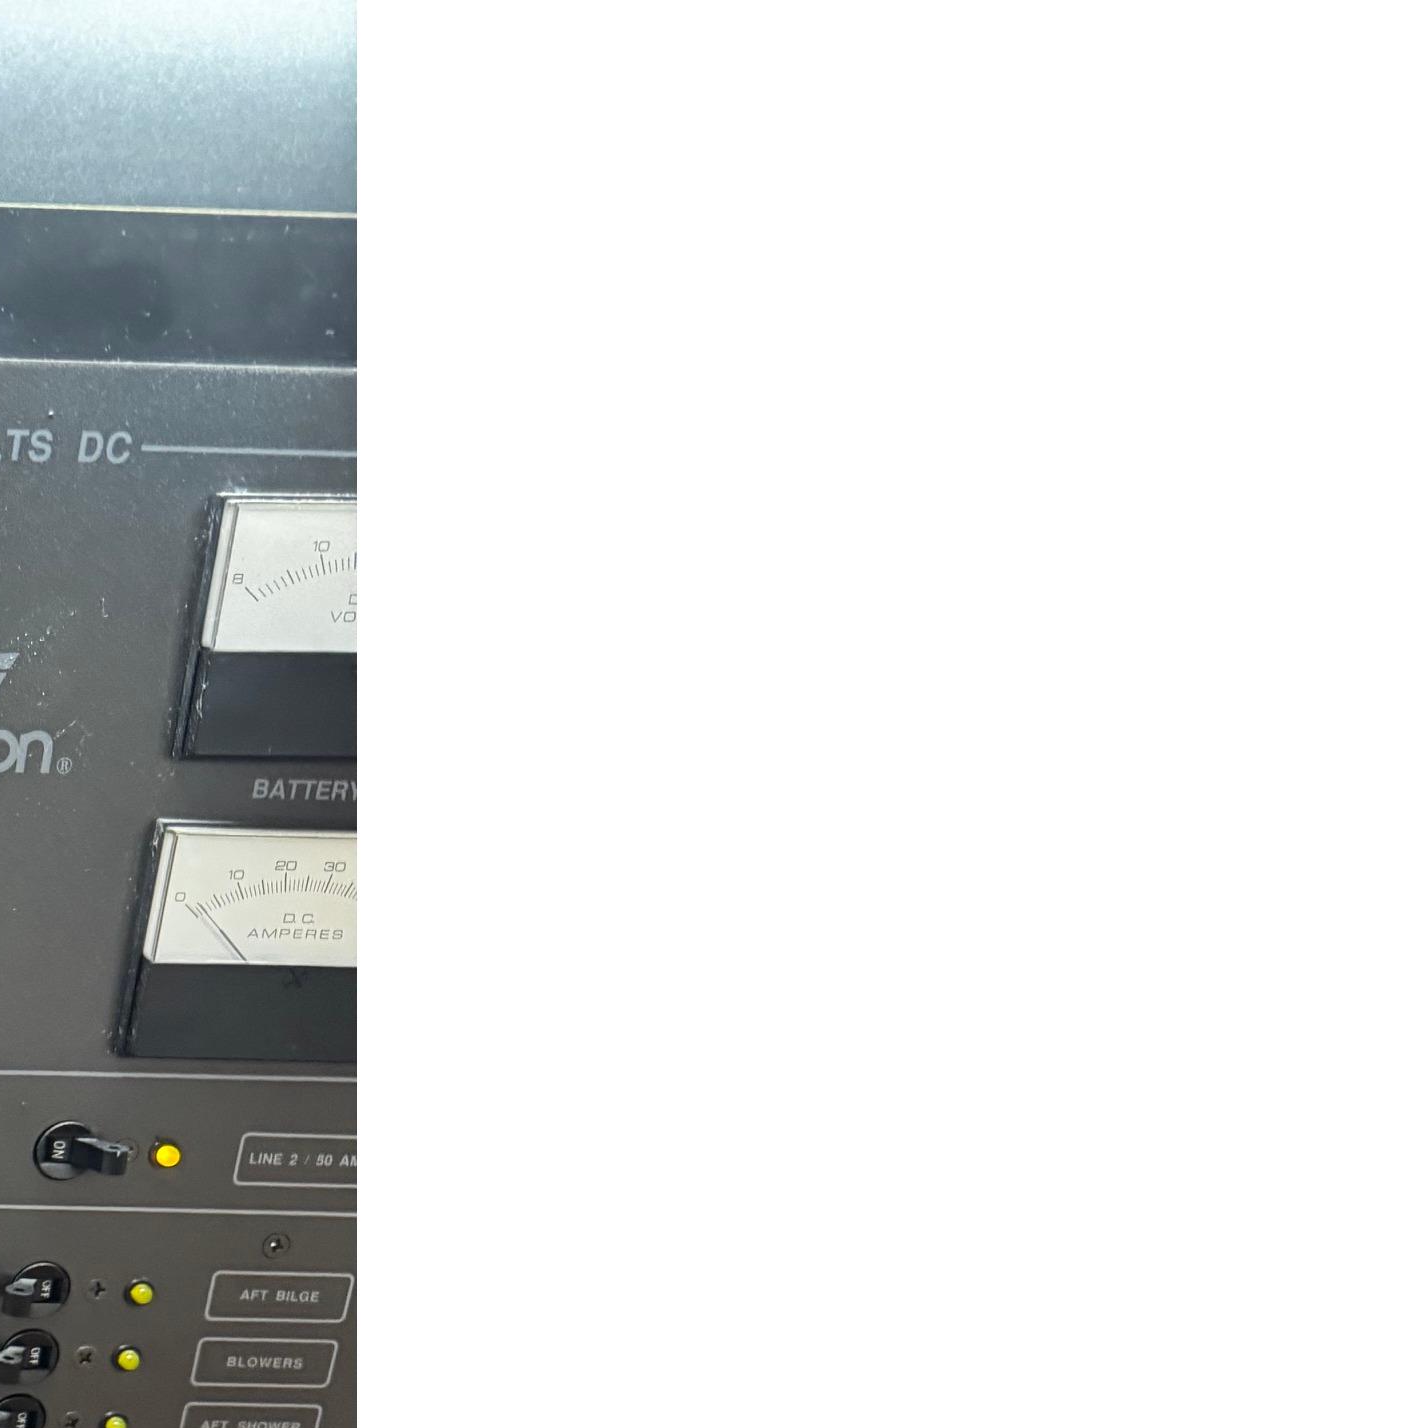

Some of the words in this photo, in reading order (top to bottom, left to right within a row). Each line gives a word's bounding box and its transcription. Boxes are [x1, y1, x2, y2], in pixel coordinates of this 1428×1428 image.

[77, 431, 133, 464] DC
[247, 928, 344, 940] AMPERES
[52, 1140, 65, 1159] ON
[249, 1152, 282, 1165] LINE
[240, 1290, 267, 1301] AFT
[276, 1291, 319, 1302] BILGE
[227, 1357, 303, 1369] BLOWERS
